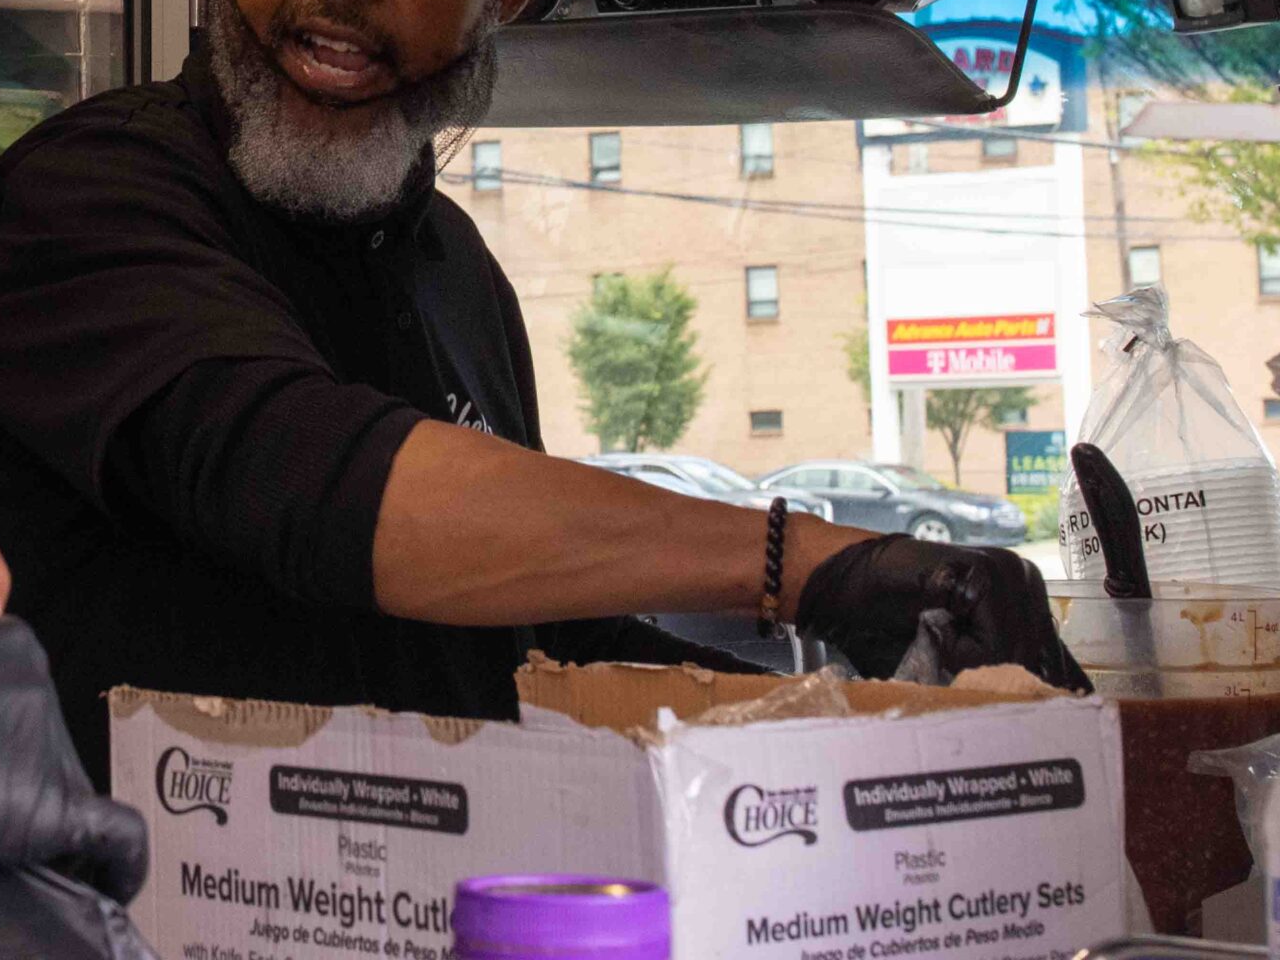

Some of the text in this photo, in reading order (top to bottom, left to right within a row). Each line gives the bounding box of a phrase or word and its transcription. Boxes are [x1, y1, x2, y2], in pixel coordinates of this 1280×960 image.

[953, 47, 1017, 72] ARD
[947, 349, 1017, 372] Mobile
[1137, 490, 1207, 516] ONTAI
[1144, 523, 1167, 543] K)
[156, 746, 233, 826] CHOICE
[278, 772, 460, 810] Individually Wrapped White
[854, 765, 1073, 806] Individually Wrapped White
[723, 784, 818, 847] CHOICE
[338, 835, 387, 862] Plastic
[895, 848, 946, 871] Plastic
[181, 862, 454, 933] Medium Weight Cutl
[747, 882, 1085, 945] Medium Weight Cutlery Sets
[250, 918, 289, 943] Juego
[292, 924, 310, 943] de
[313, 927, 380, 954] Cubiertos
[383, 937, 400, 956] de
[404, 941, 437, 960] Peso
[847, 943, 866, 959] de
[870, 935, 941, 957] Cubiertos
[944, 931, 962, 949] de
[965, 928, 999, 946] Peso
[1003, 920, 1045, 940] Medio
